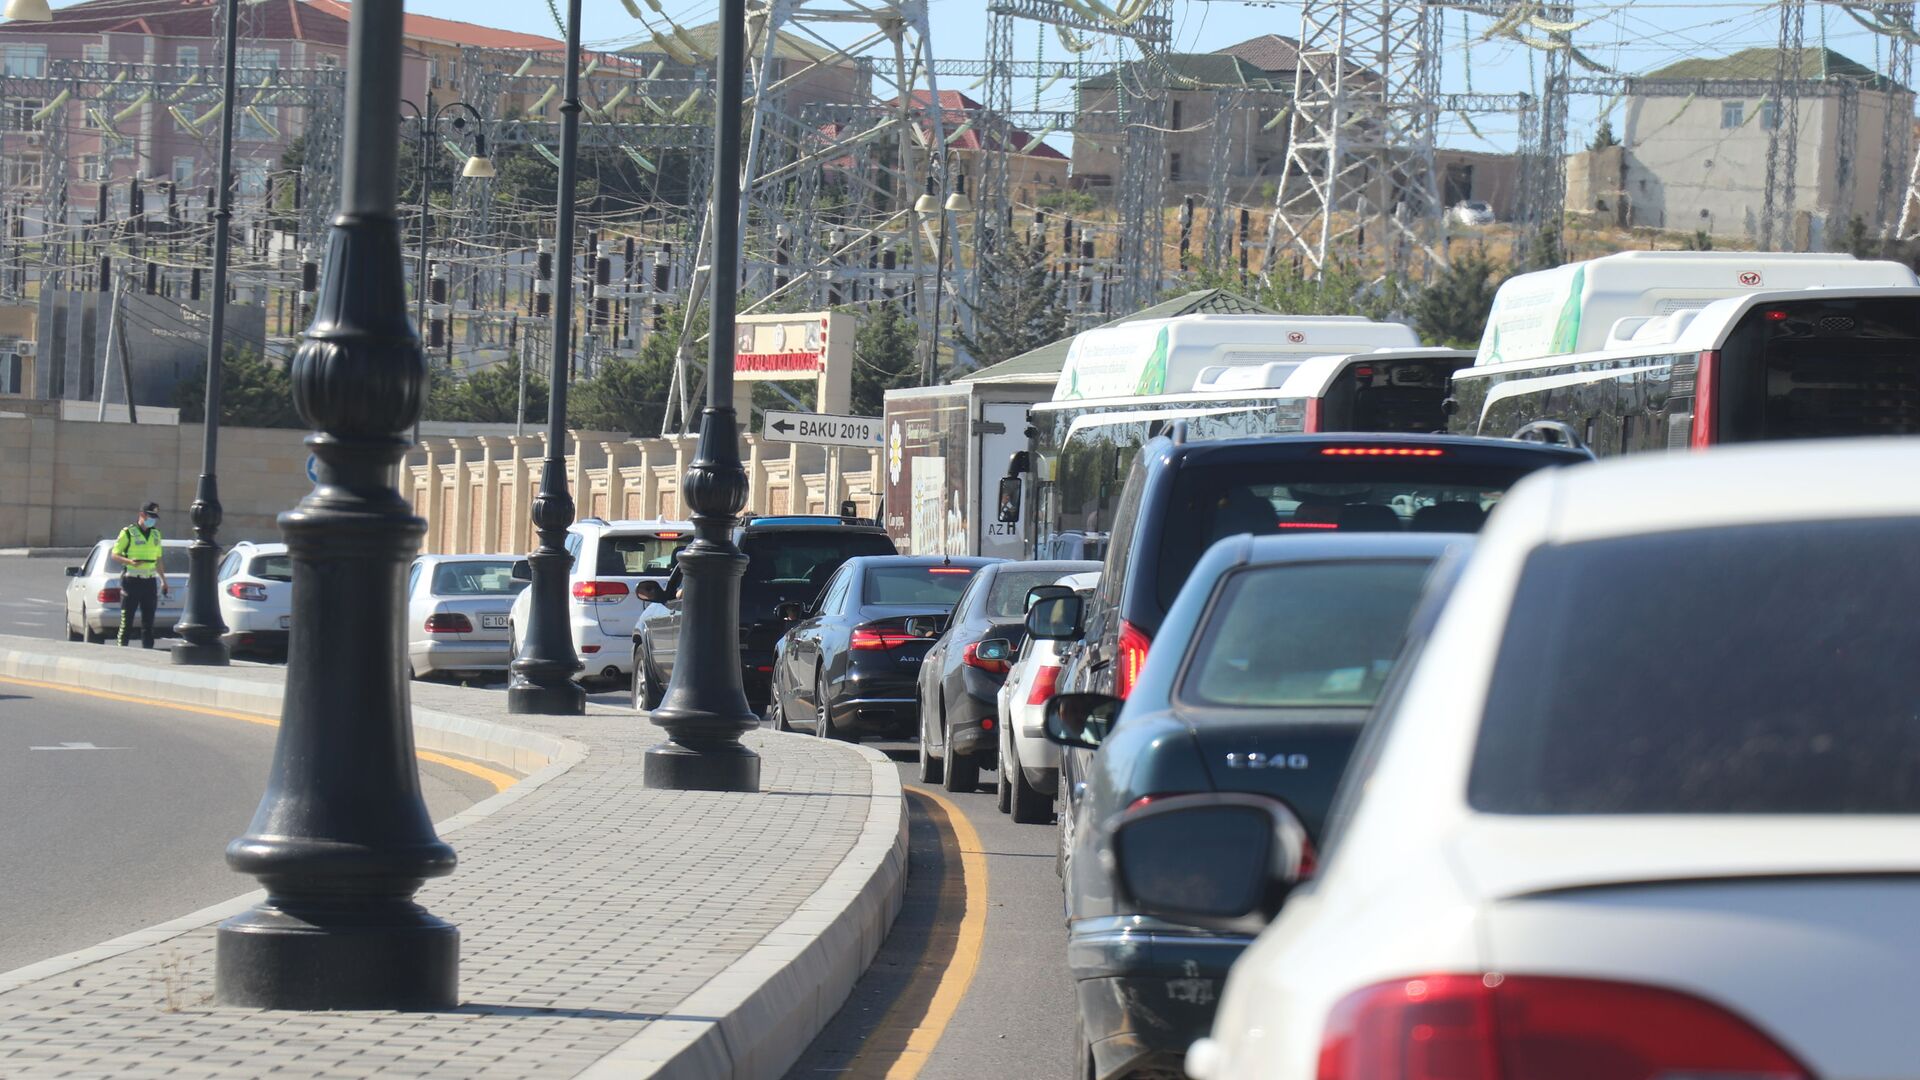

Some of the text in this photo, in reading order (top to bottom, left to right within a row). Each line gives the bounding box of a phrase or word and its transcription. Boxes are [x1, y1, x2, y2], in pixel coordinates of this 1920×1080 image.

[800, 421, 869, 440] BAKU 2019
[989, 523, 1004, 536] AZ
